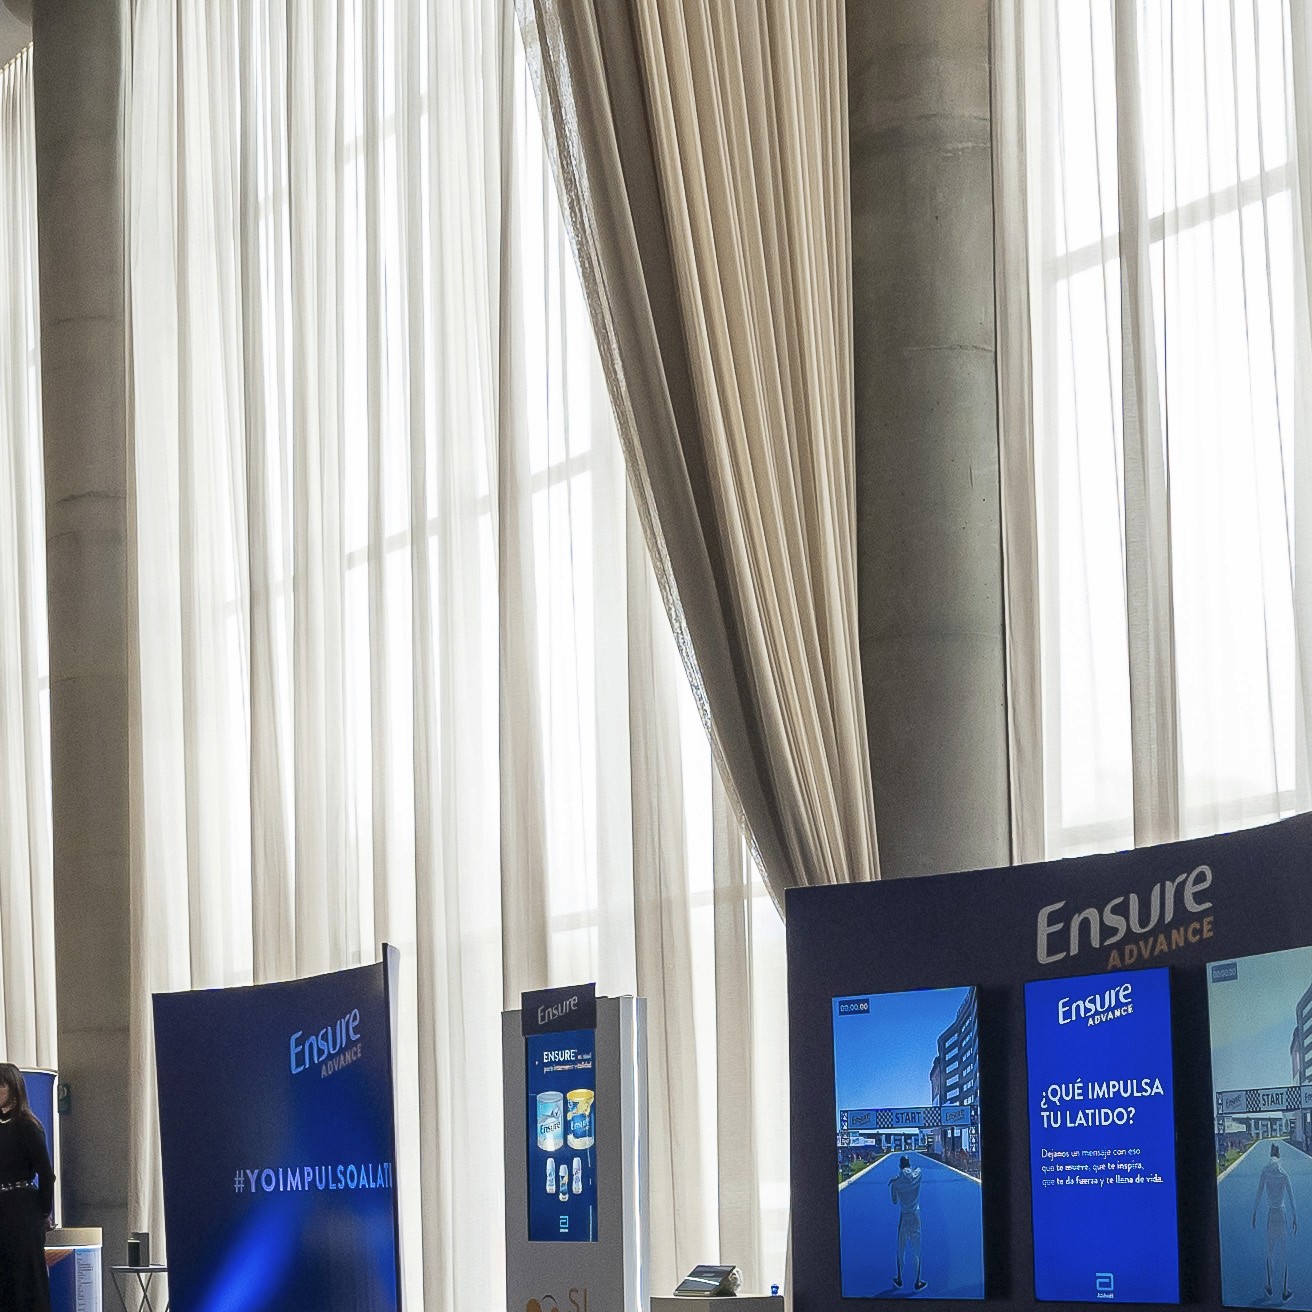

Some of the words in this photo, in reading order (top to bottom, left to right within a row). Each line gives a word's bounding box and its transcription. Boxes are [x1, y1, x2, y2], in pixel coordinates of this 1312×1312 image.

[1036, 864, 1213, 964] Ensure
[1107, 915, 1214, 970] ADVANCE
[537, 995, 578, 1025] Ensure
[1058, 983, 1132, 1025] Ensure
[1087, 1003, 1134, 1027] ADVANCE
[290, 1008, 361, 1075] Ensure
[320, 1043, 362, 1079] ADVANCE
[1040, 1077, 1084, 1109] ¿QUÉ
[1088, 1078, 1164, 1100] IMPULSA
[1261, 1091, 1285, 1107] START
[894, 1111, 922, 1124] START
[1040, 1110, 1062, 1128] TU
[1066, 1107, 1136, 1128] LATIDO?
[234, 1162, 393, 1193] #YOIMPULSOALATI
